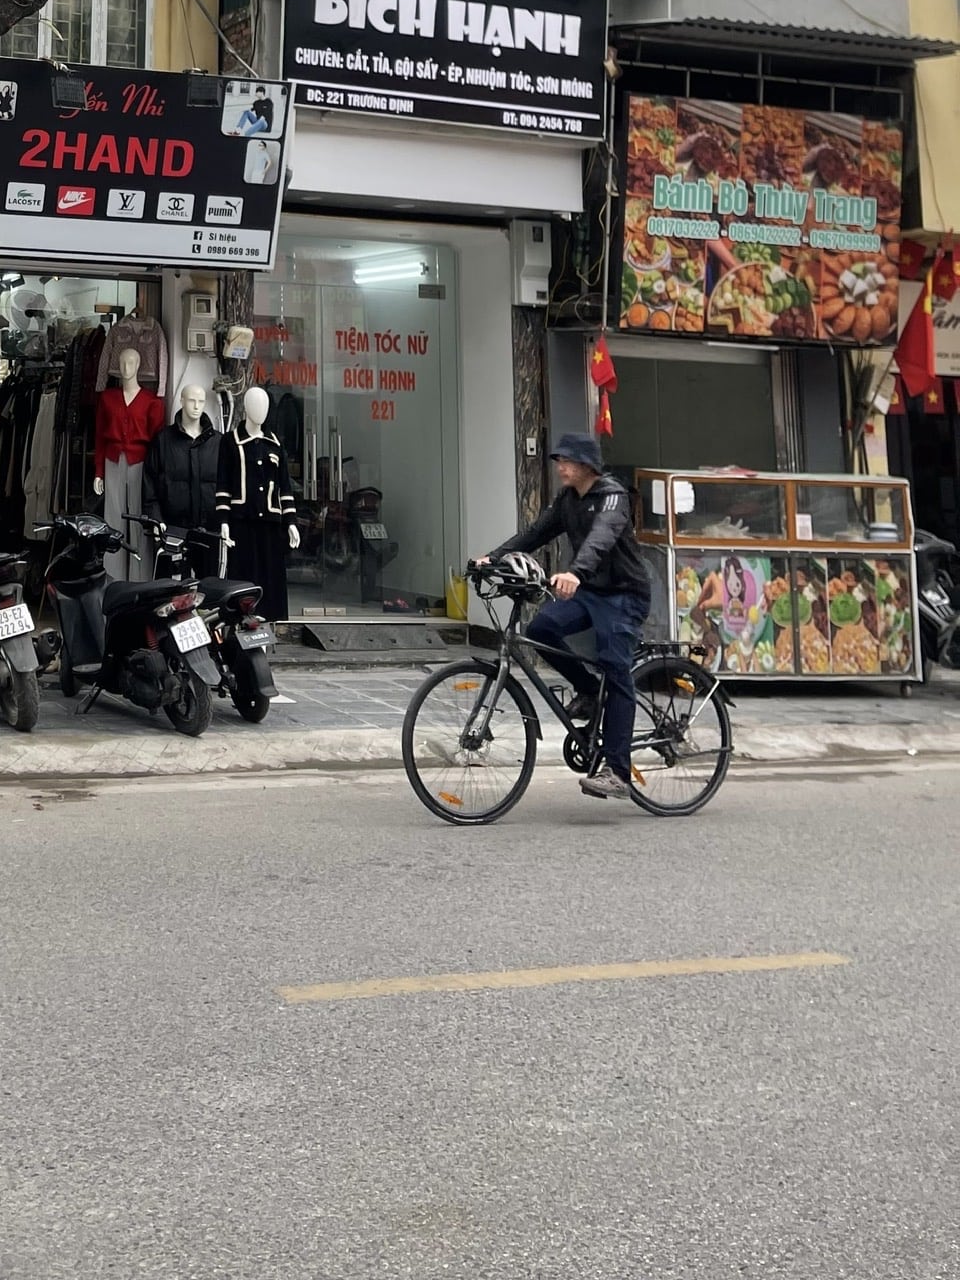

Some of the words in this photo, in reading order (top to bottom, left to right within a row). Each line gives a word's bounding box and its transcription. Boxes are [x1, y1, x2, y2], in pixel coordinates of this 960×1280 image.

[295, 46, 344, 69] CHUYÊN:
[395, 57, 414, 81] GỘI
[416, 57, 439, 80] SẤY
[466, 66, 507, 91] NHUỘM
[509, 70, 535, 94] TÓC,
[536, 75, 560, 96] SƠN
[561, 77, 594, 100] MÓNG
[306, 88, 325, 102] ĐC:
[326, 91, 344, 105] 221
[389, 99, 415, 115] ĐỊNH
[19, 128, 196, 178] 2HAND
[8, 197, 41, 206] LACOSTE
[160, 209, 189, 218] CHANEL
[207, 207, 234, 218] PUMA
[653, 173, 714, 213] Bánh
[718, 177, 749, 216] Bò
[753, 183, 809, 225] Thùy
[814, 187, 878, 231] Trang
[335, 327, 370, 355] TIỆM
[373, 329, 401, 354] TÓC
[343, 363, 374, 389] BÍCH
[379, 368, 416, 394] HẠNH
[370, 400, 396, 421] 221
